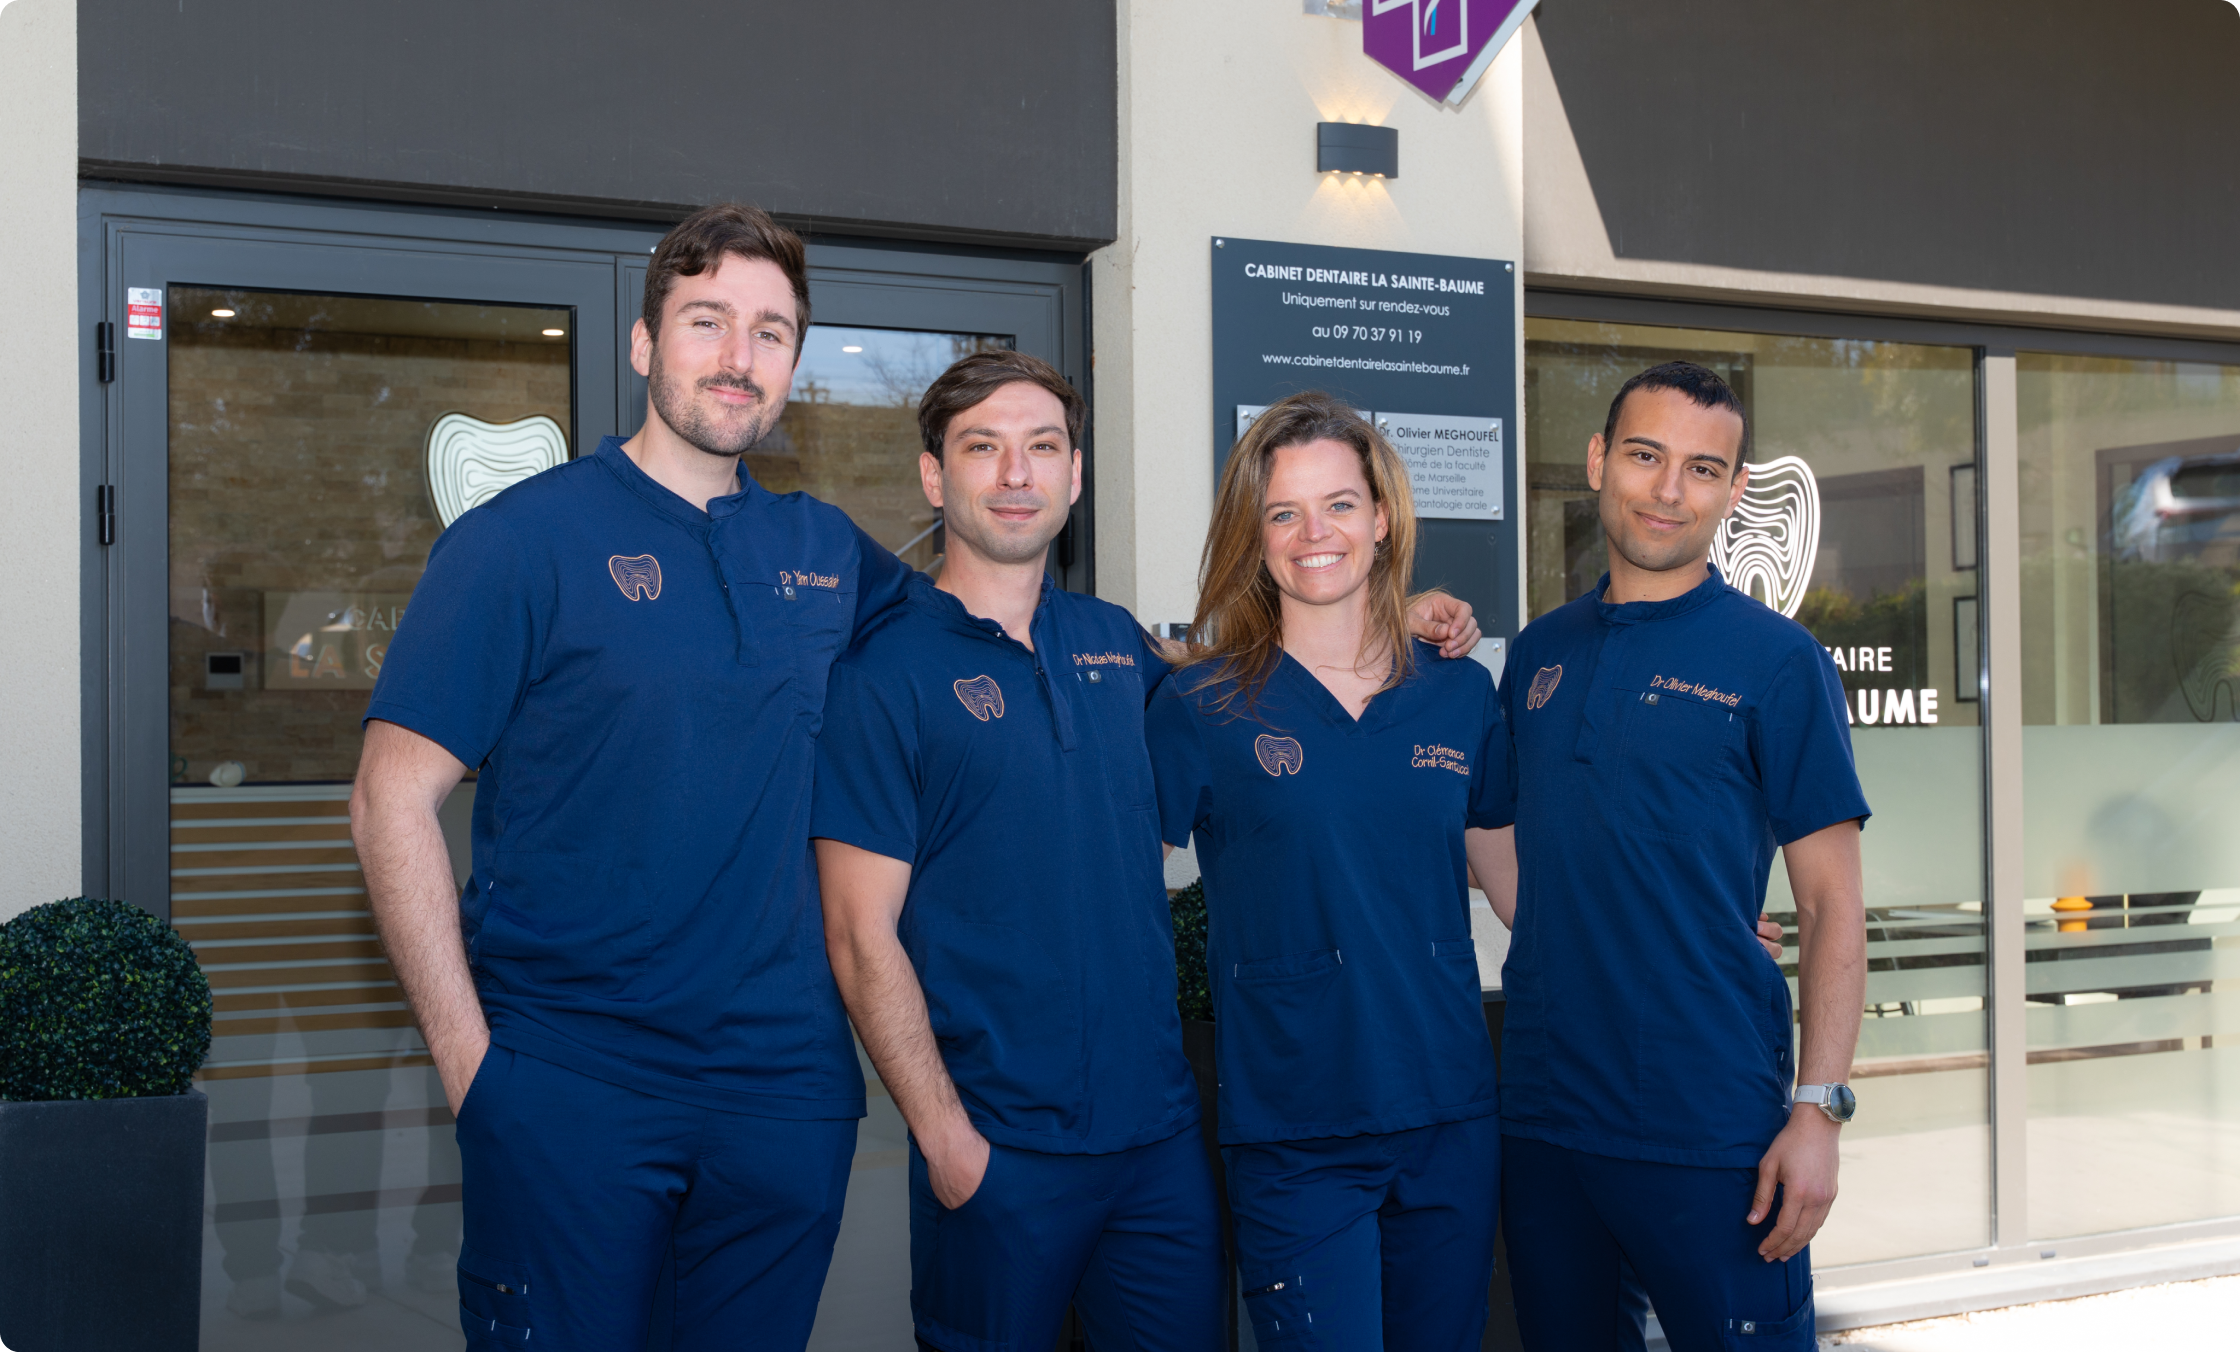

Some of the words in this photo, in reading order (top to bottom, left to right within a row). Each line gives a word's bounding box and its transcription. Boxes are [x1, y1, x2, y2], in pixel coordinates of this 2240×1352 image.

[1244, 263, 1303, 281] CABINET
[1306, 267, 1368, 286] DENTAIRE
[1371, 273, 1388, 287] LA
[1390, 274, 1485, 295] SAINTE-BAUME
[131, 305, 159, 313] Alarme
[1282, 291, 1357, 309] Uniquement
[1359, 300, 1377, 311] sur
[1378, 300, 1450, 317] rendez-vous
[1312, 326, 1330, 338] au
[1333, 324, 1349, 339] 09
[1352, 326, 1368, 341] 70
[1370, 327, 1386, 342] 37
[1389, 328, 1402, 343] 91
[1408, 330, 1422, 344] 19
[1262, 353, 1470, 376] www.cabinetdentairelasaintebaume.fr
[1396, 427, 1431, 440] Olivier
[1434, 429, 1499, 442] MEGHOUFEL
[1447, 445, 1490, 458] Dentiste
[1430, 460, 1442, 470] de
[1444, 460, 1453, 470] la
[1455, 460, 1486, 471] faculté
[1413, 472, 1426, 482] de
[1428, 473, 1466, 484] Marseille
[1432, 486, 1484, 497] Universitaire
[1413, 499, 1463, 511] plantologie
[1465, 502, 1488, 510] orale
[779, 570, 792, 585] Dr
[1072, 653, 1083, 666] Dr
[1824, 646, 1893, 672] AIRE
[1650, 674, 1665, 688] Dr
[1663, 677, 1693, 693] Olivier
[1691, 682, 1743, 708] Meghoufel
[1414, 744, 1426, 756] Dr
[1427, 743, 1465, 761] Clémence
